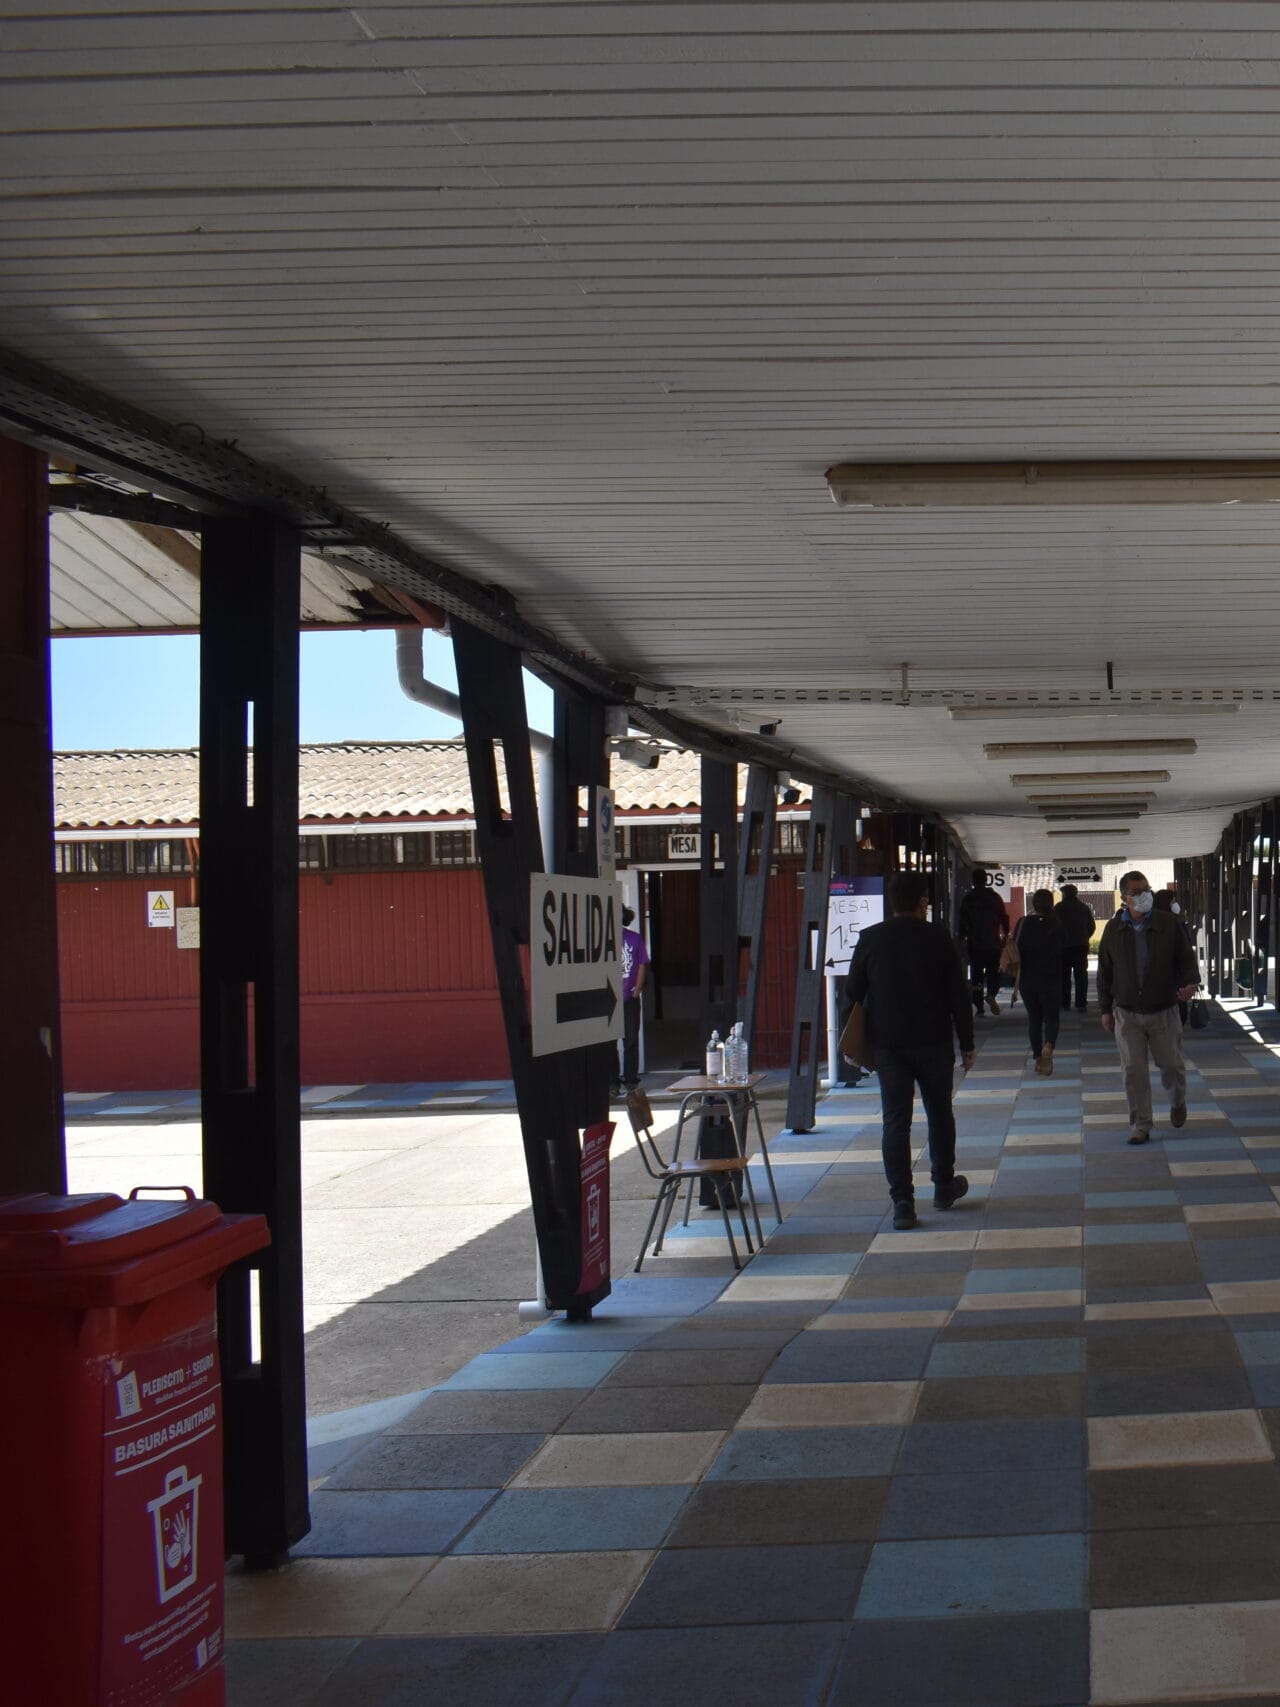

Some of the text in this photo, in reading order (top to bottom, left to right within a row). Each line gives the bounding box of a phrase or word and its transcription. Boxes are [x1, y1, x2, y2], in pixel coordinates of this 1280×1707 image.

[671, 836, 697, 853] MESA
[1061, 866, 1097, 874] SALIDA
[543, 889, 617, 967] SALIDA
[142, 1368, 184, 1398] PLEBISCITO
[114, 1402, 216, 1464] BASURA SANITARIA
